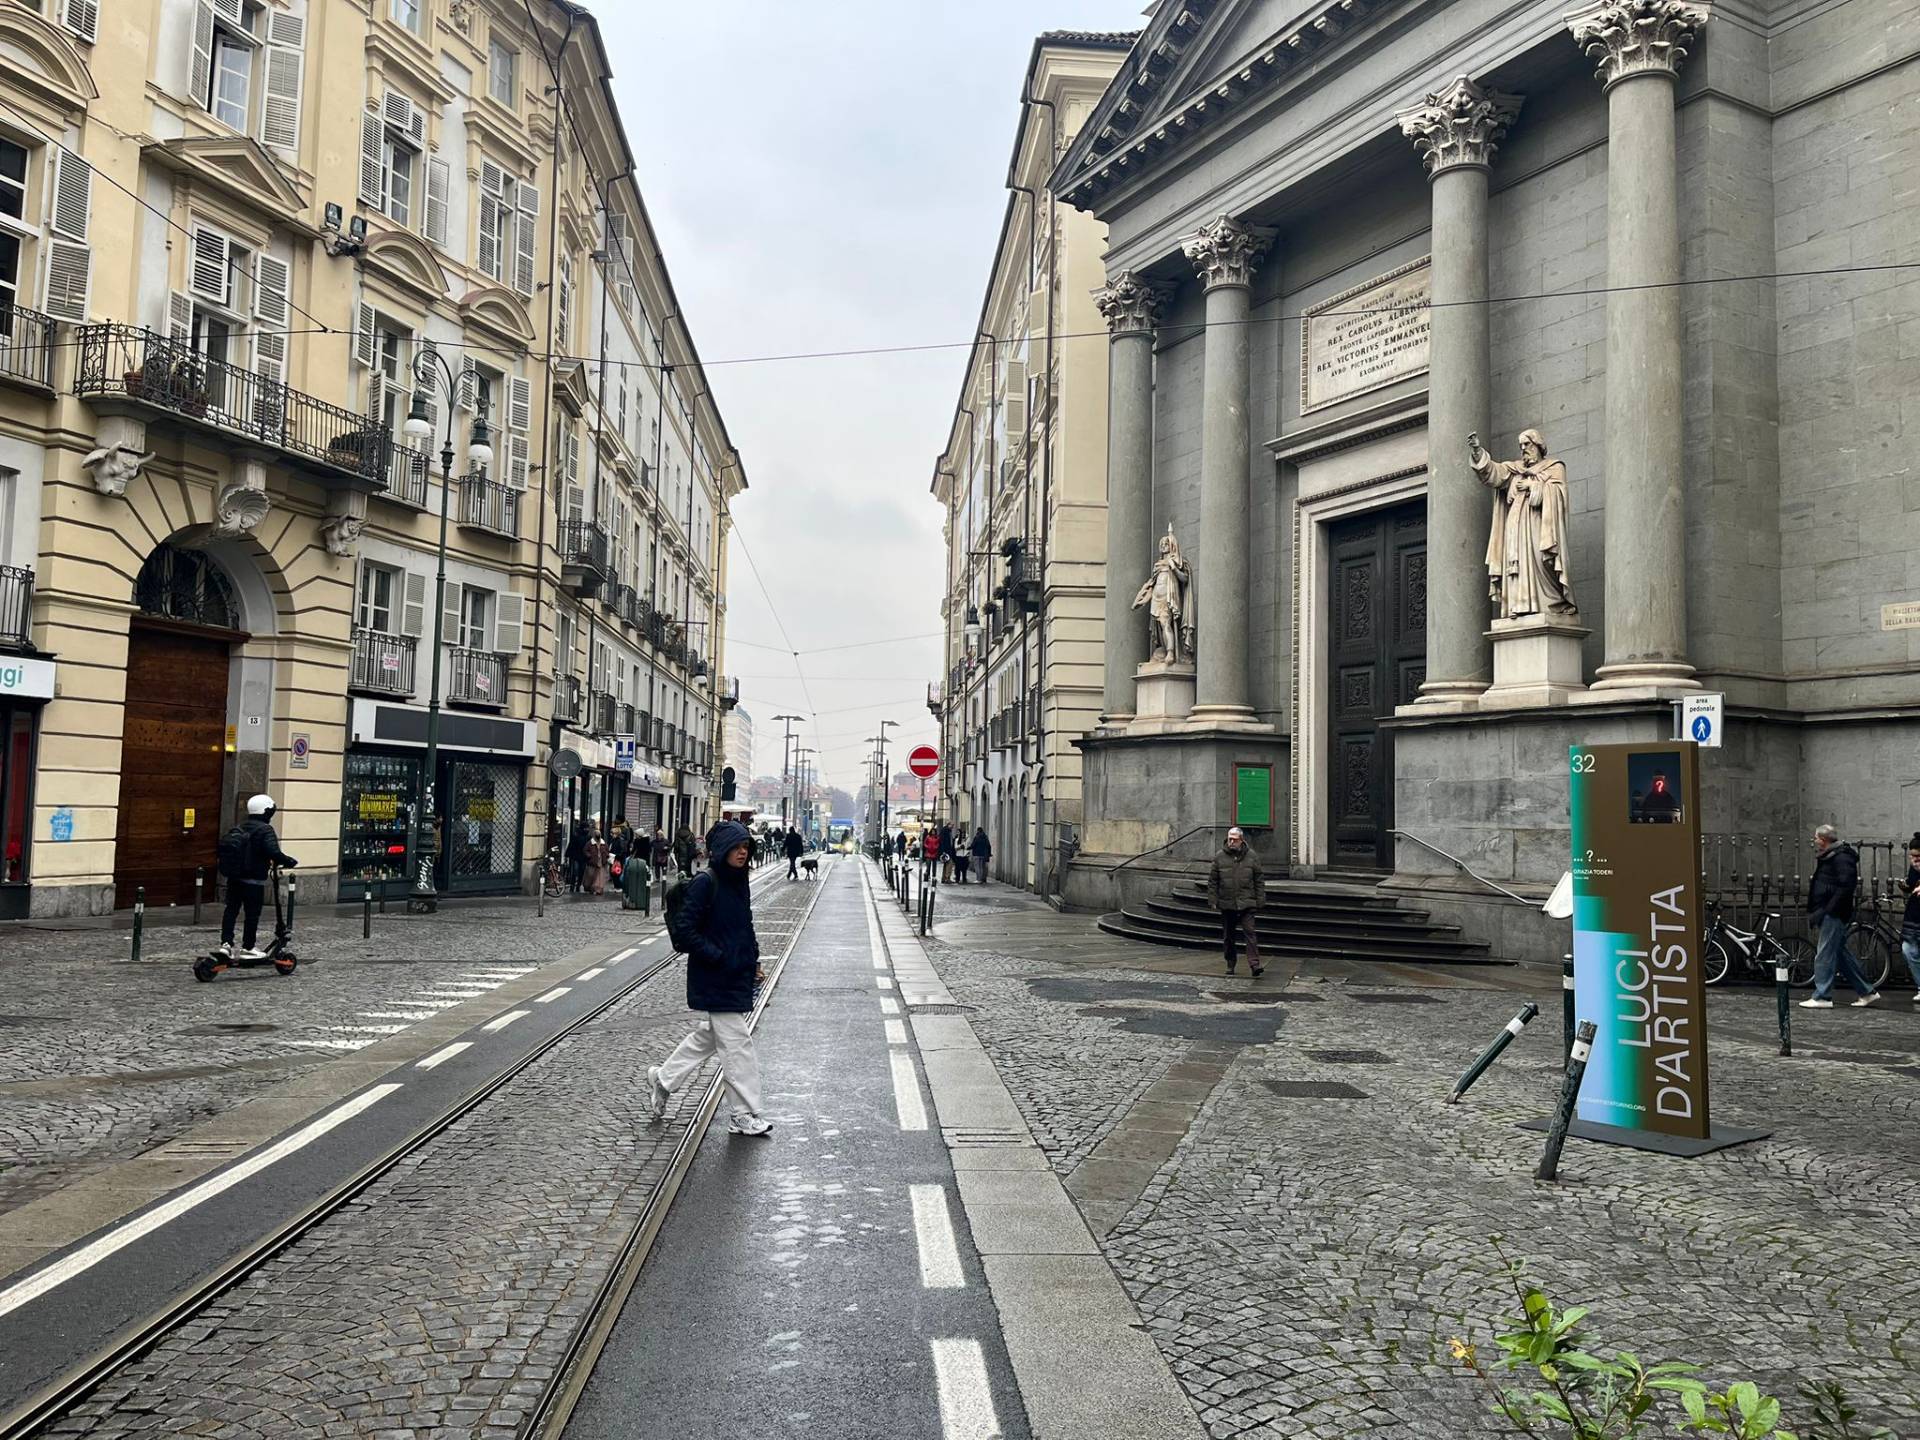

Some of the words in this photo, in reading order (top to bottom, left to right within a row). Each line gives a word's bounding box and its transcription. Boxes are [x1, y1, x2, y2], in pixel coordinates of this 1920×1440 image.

[1327, 335, 1343, 347] REX
[1348, 318, 1383, 338] CAROLVS
[1366, 326, 1394, 341] LAPIDEO
[1398, 317, 1418, 328] AVXIT
[1317, 362, 1332, 373] REX
[1337, 343, 1379, 364] VICTORIVS
[1350, 355, 1379, 369] PICTVRIS
[1360, 359, 1394, 377] EXORNAVIT
[1689, 705, 1715, 713] pedonale
[250, 717, 259, 725] 13
[1572, 754, 1596, 773] 32
[1616, 950, 1651, 1048] LUCI
[1650, 885, 1692, 1118] D'ARTISTA
